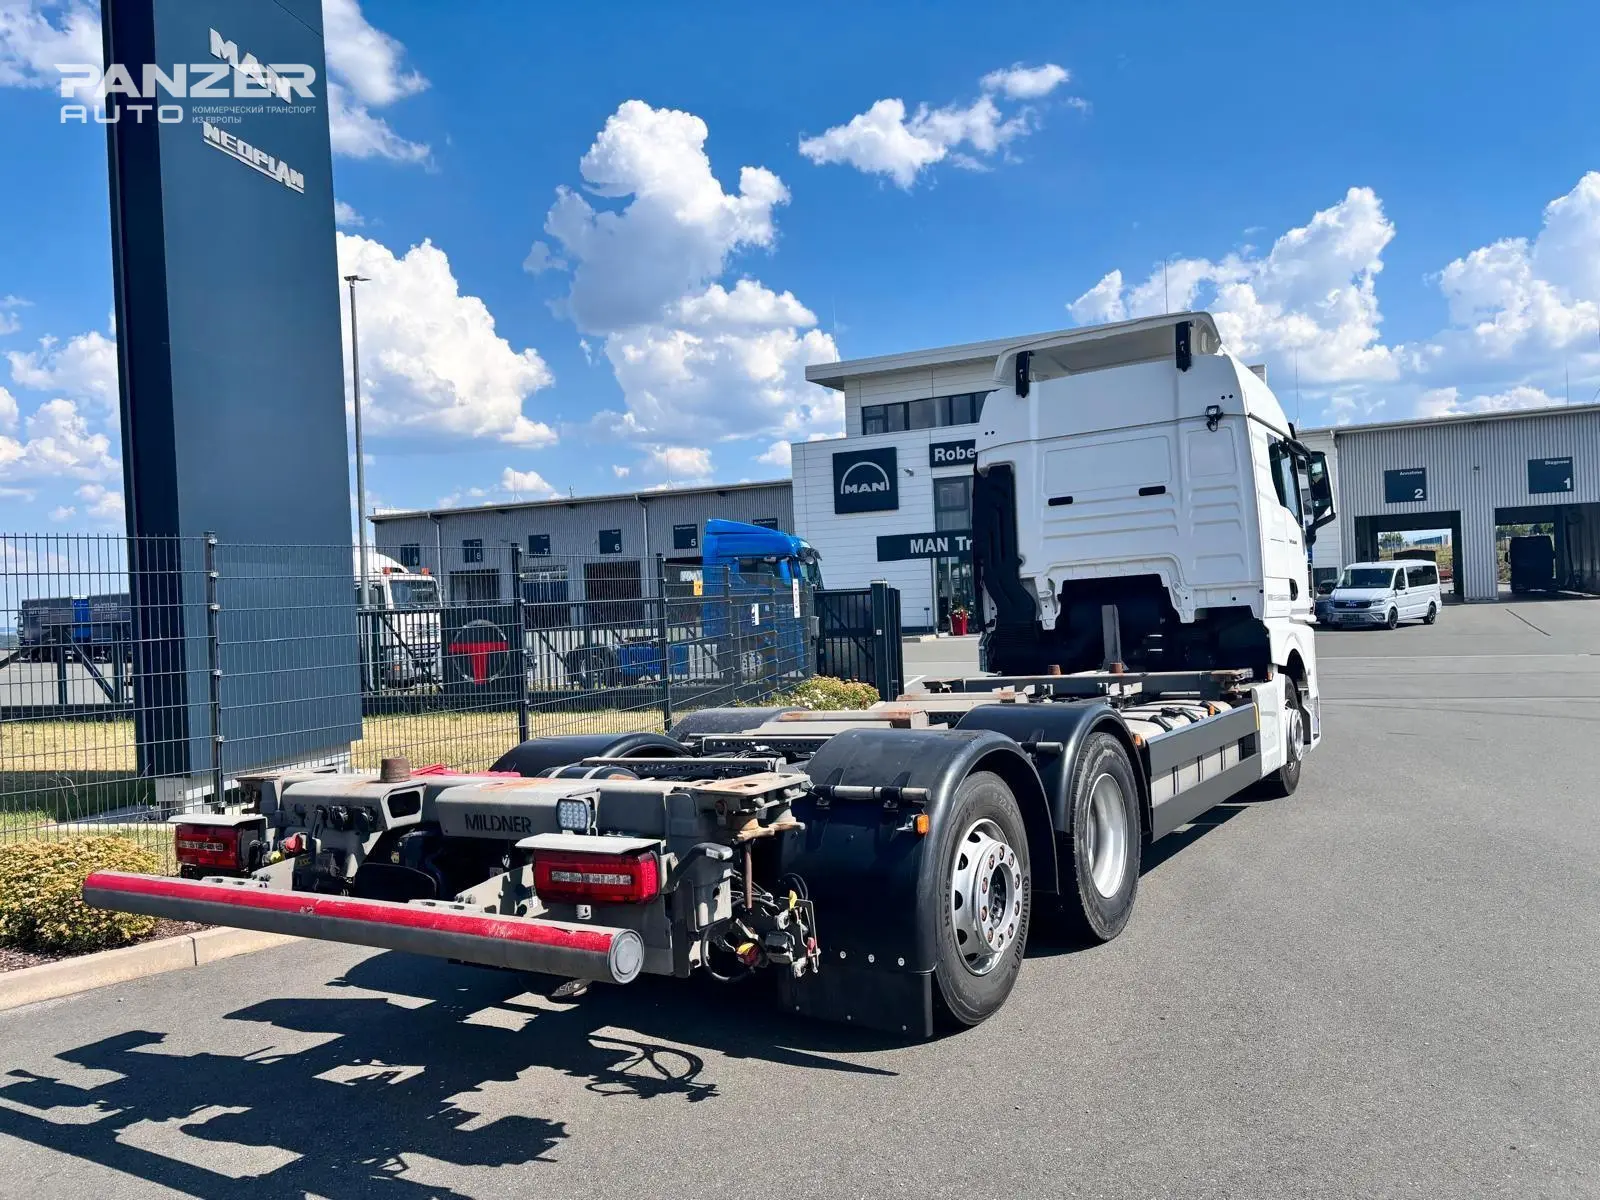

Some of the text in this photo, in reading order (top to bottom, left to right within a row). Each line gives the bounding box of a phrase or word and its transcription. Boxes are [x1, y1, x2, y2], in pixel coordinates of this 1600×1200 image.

[209, 27, 292, 104] MAN
[203, 120, 304, 190] NEOPLAN
[844, 481, 886, 494] MAN
[1563, 477, 1571, 489] 1
[1414, 488, 1424, 499] 2
[614, 543, 621, 552] 6
[690, 538, 697, 547] 5
[910, 537, 949, 553] MAN
[464, 813, 533, 833] MILDNER
[1015, 875, 1031, 963] Continental
